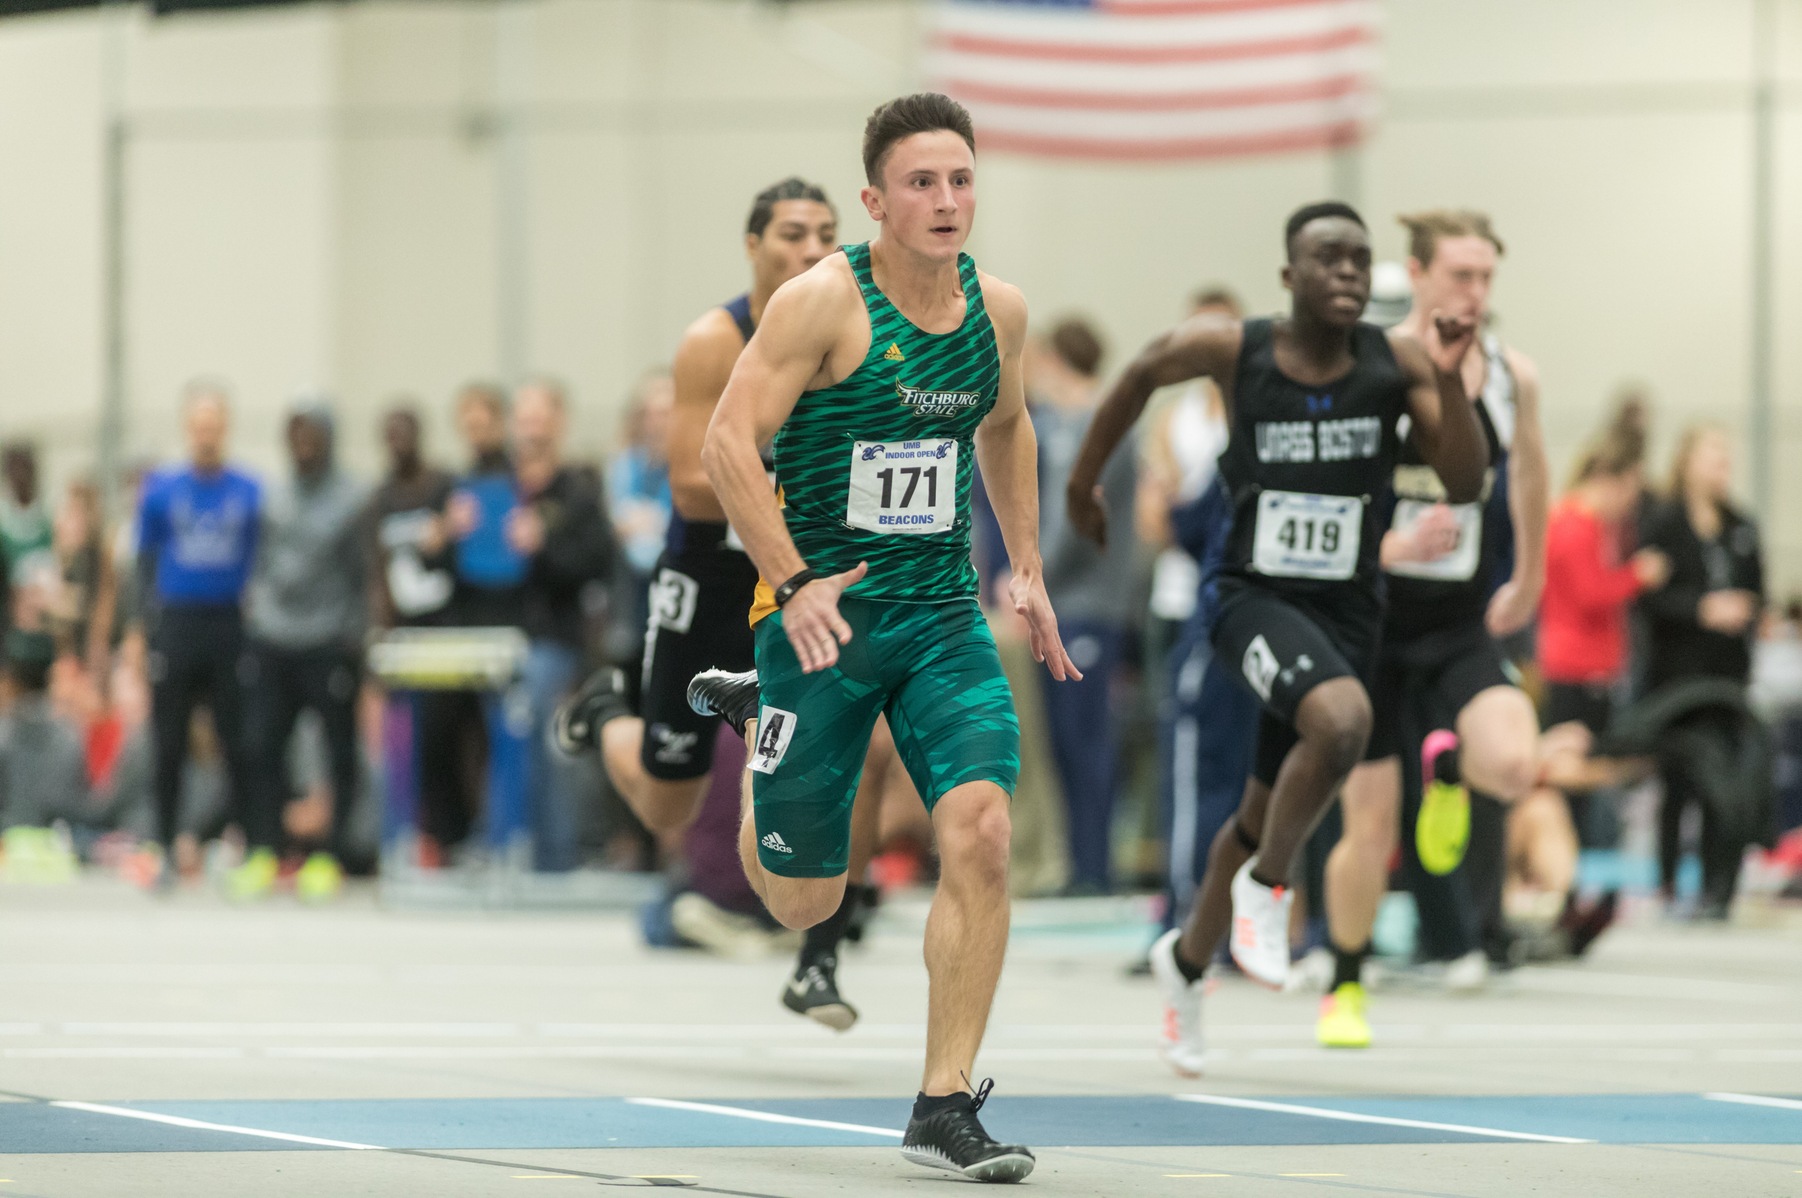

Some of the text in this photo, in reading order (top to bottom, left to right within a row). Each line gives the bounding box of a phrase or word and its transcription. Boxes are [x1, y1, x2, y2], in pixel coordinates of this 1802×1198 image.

[901, 386, 979, 405] FITCHBURG
[915, 404, 957, 415] STATE
[903, 442, 921, 450] UMB
[885, 450, 936, 459] INDOOR OPEN
[876, 465, 937, 508] 171
[879, 514, 934, 525] BEACONS
[1277, 517, 1340, 553] 419
[659, 579, 685, 621] 3
[758, 712, 785, 768] 4
[761, 839, 792, 853] adidas
